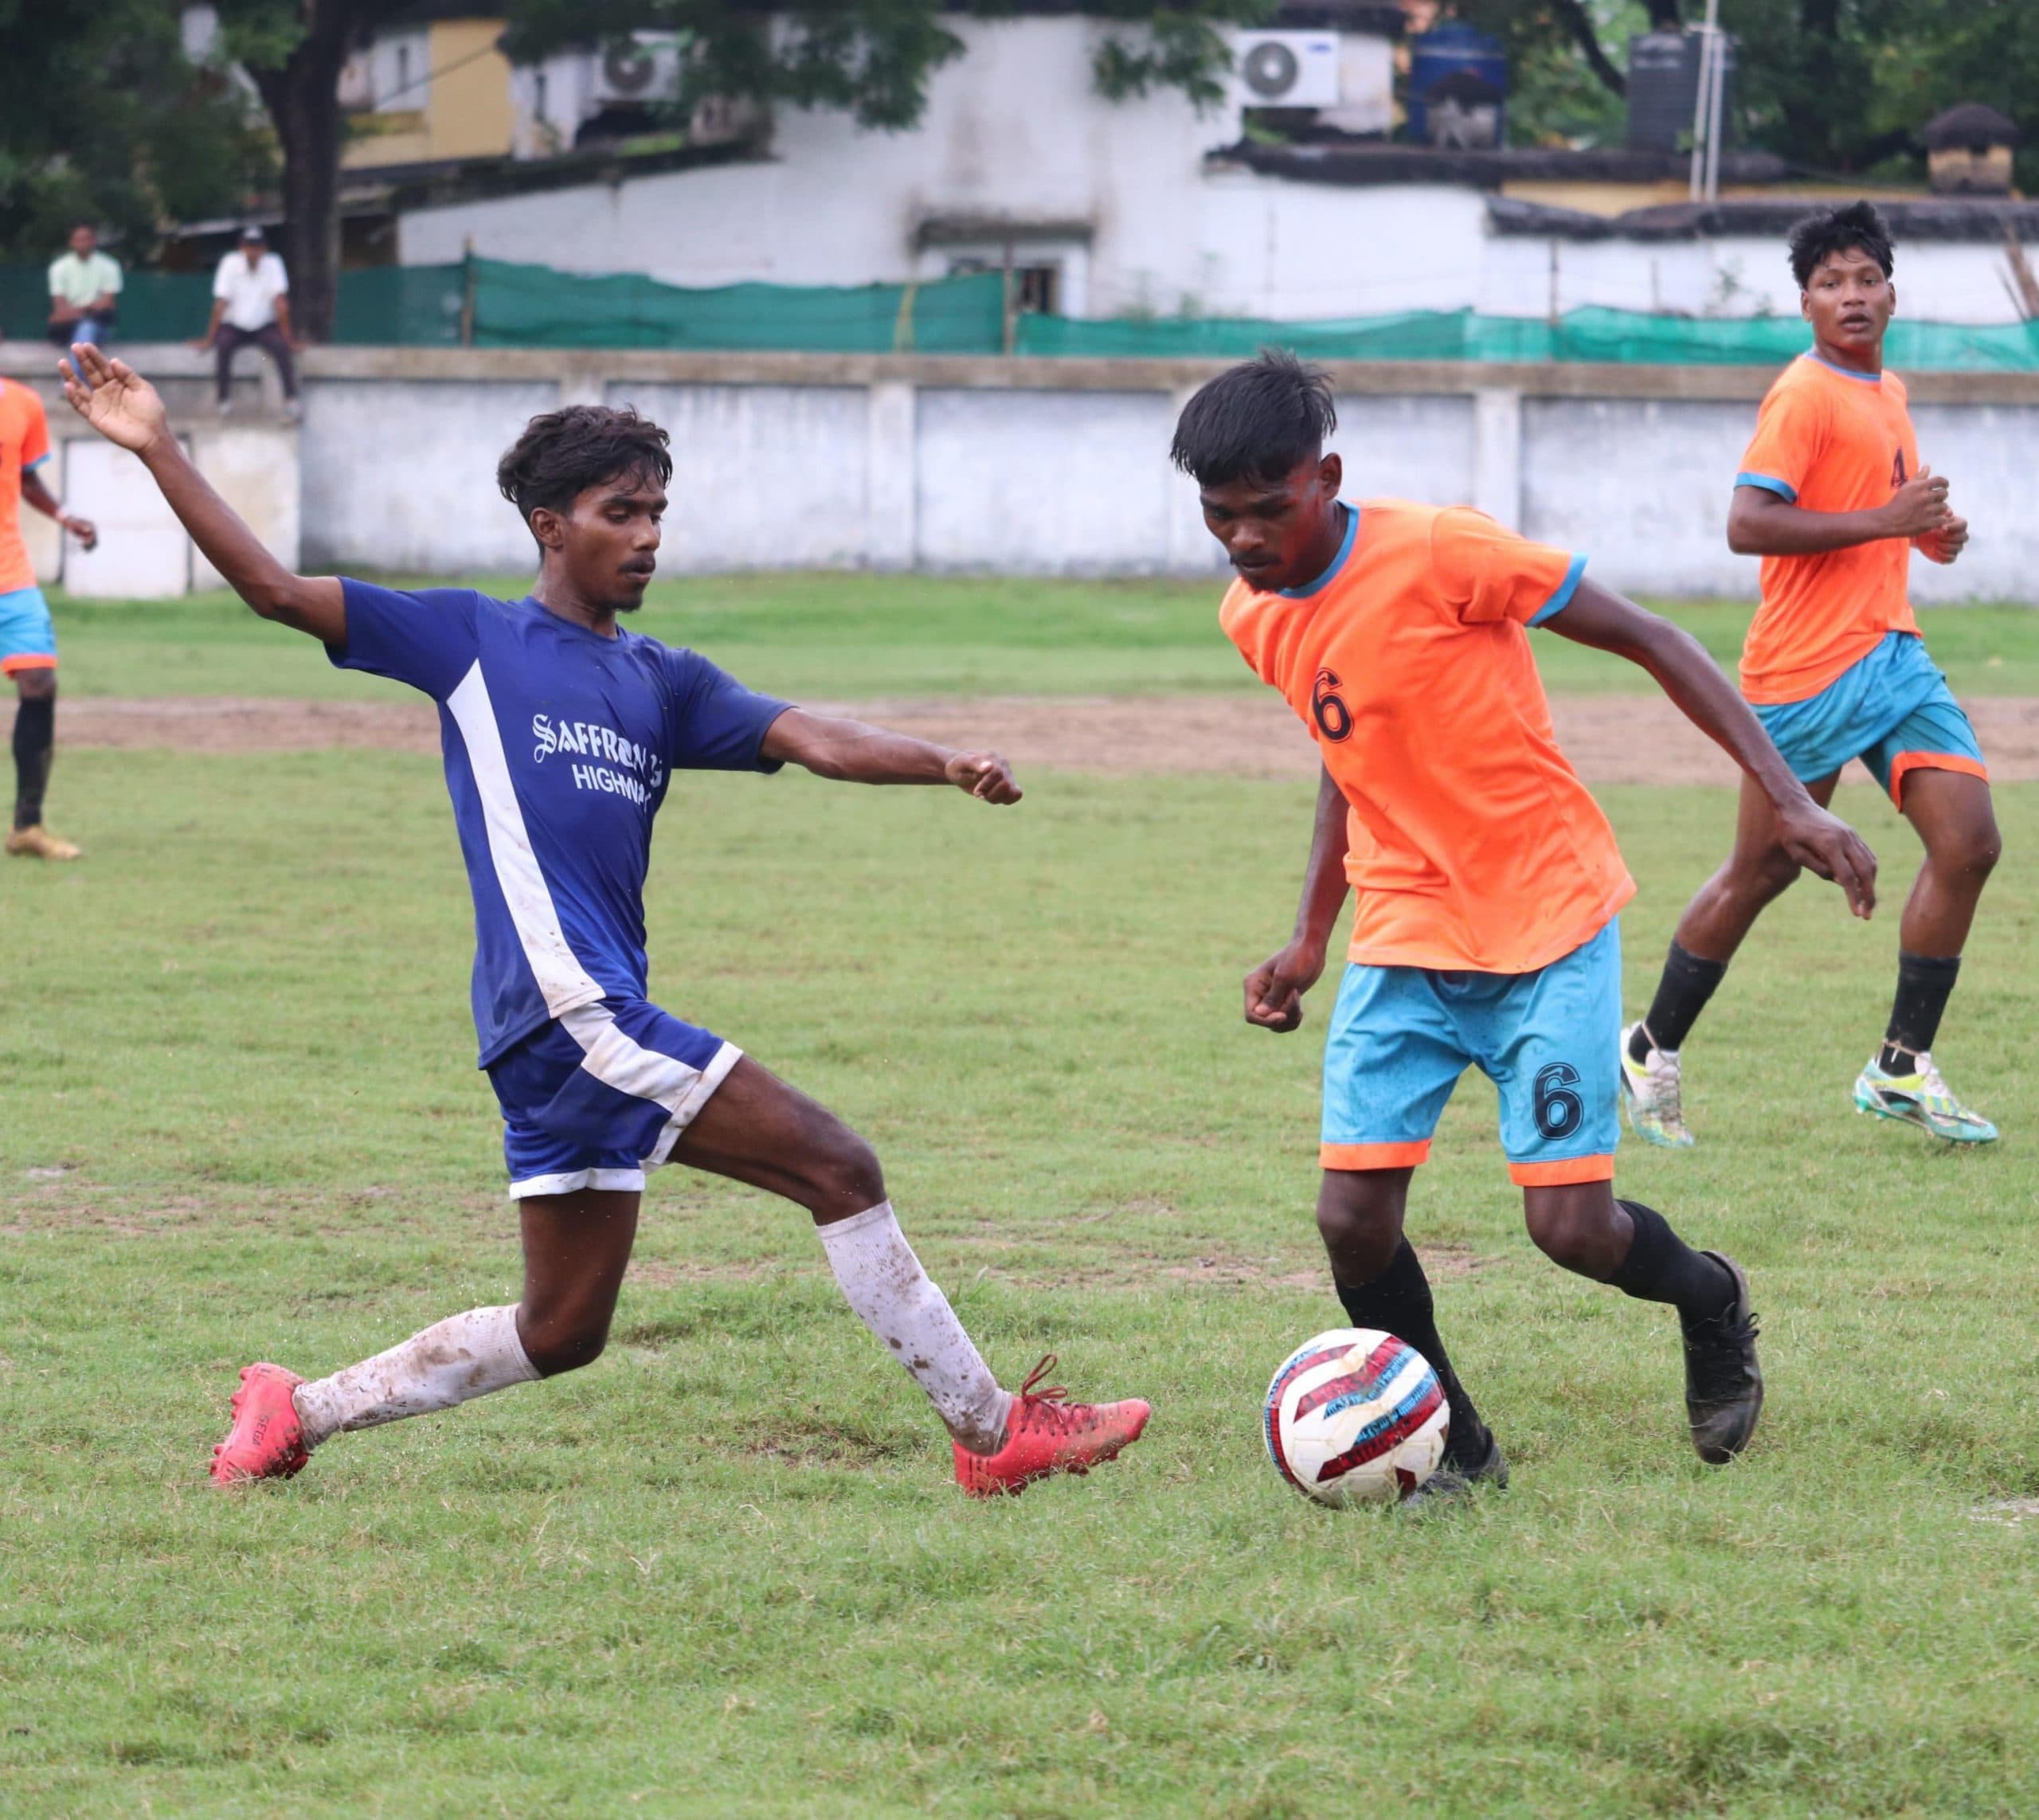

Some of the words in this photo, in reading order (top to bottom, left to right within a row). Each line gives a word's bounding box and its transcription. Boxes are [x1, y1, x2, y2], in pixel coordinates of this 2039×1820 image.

[1889, 446, 1908, 490] 4
[1312, 667, 1355, 745] 6
[1532, 1062, 1584, 1141] 6
